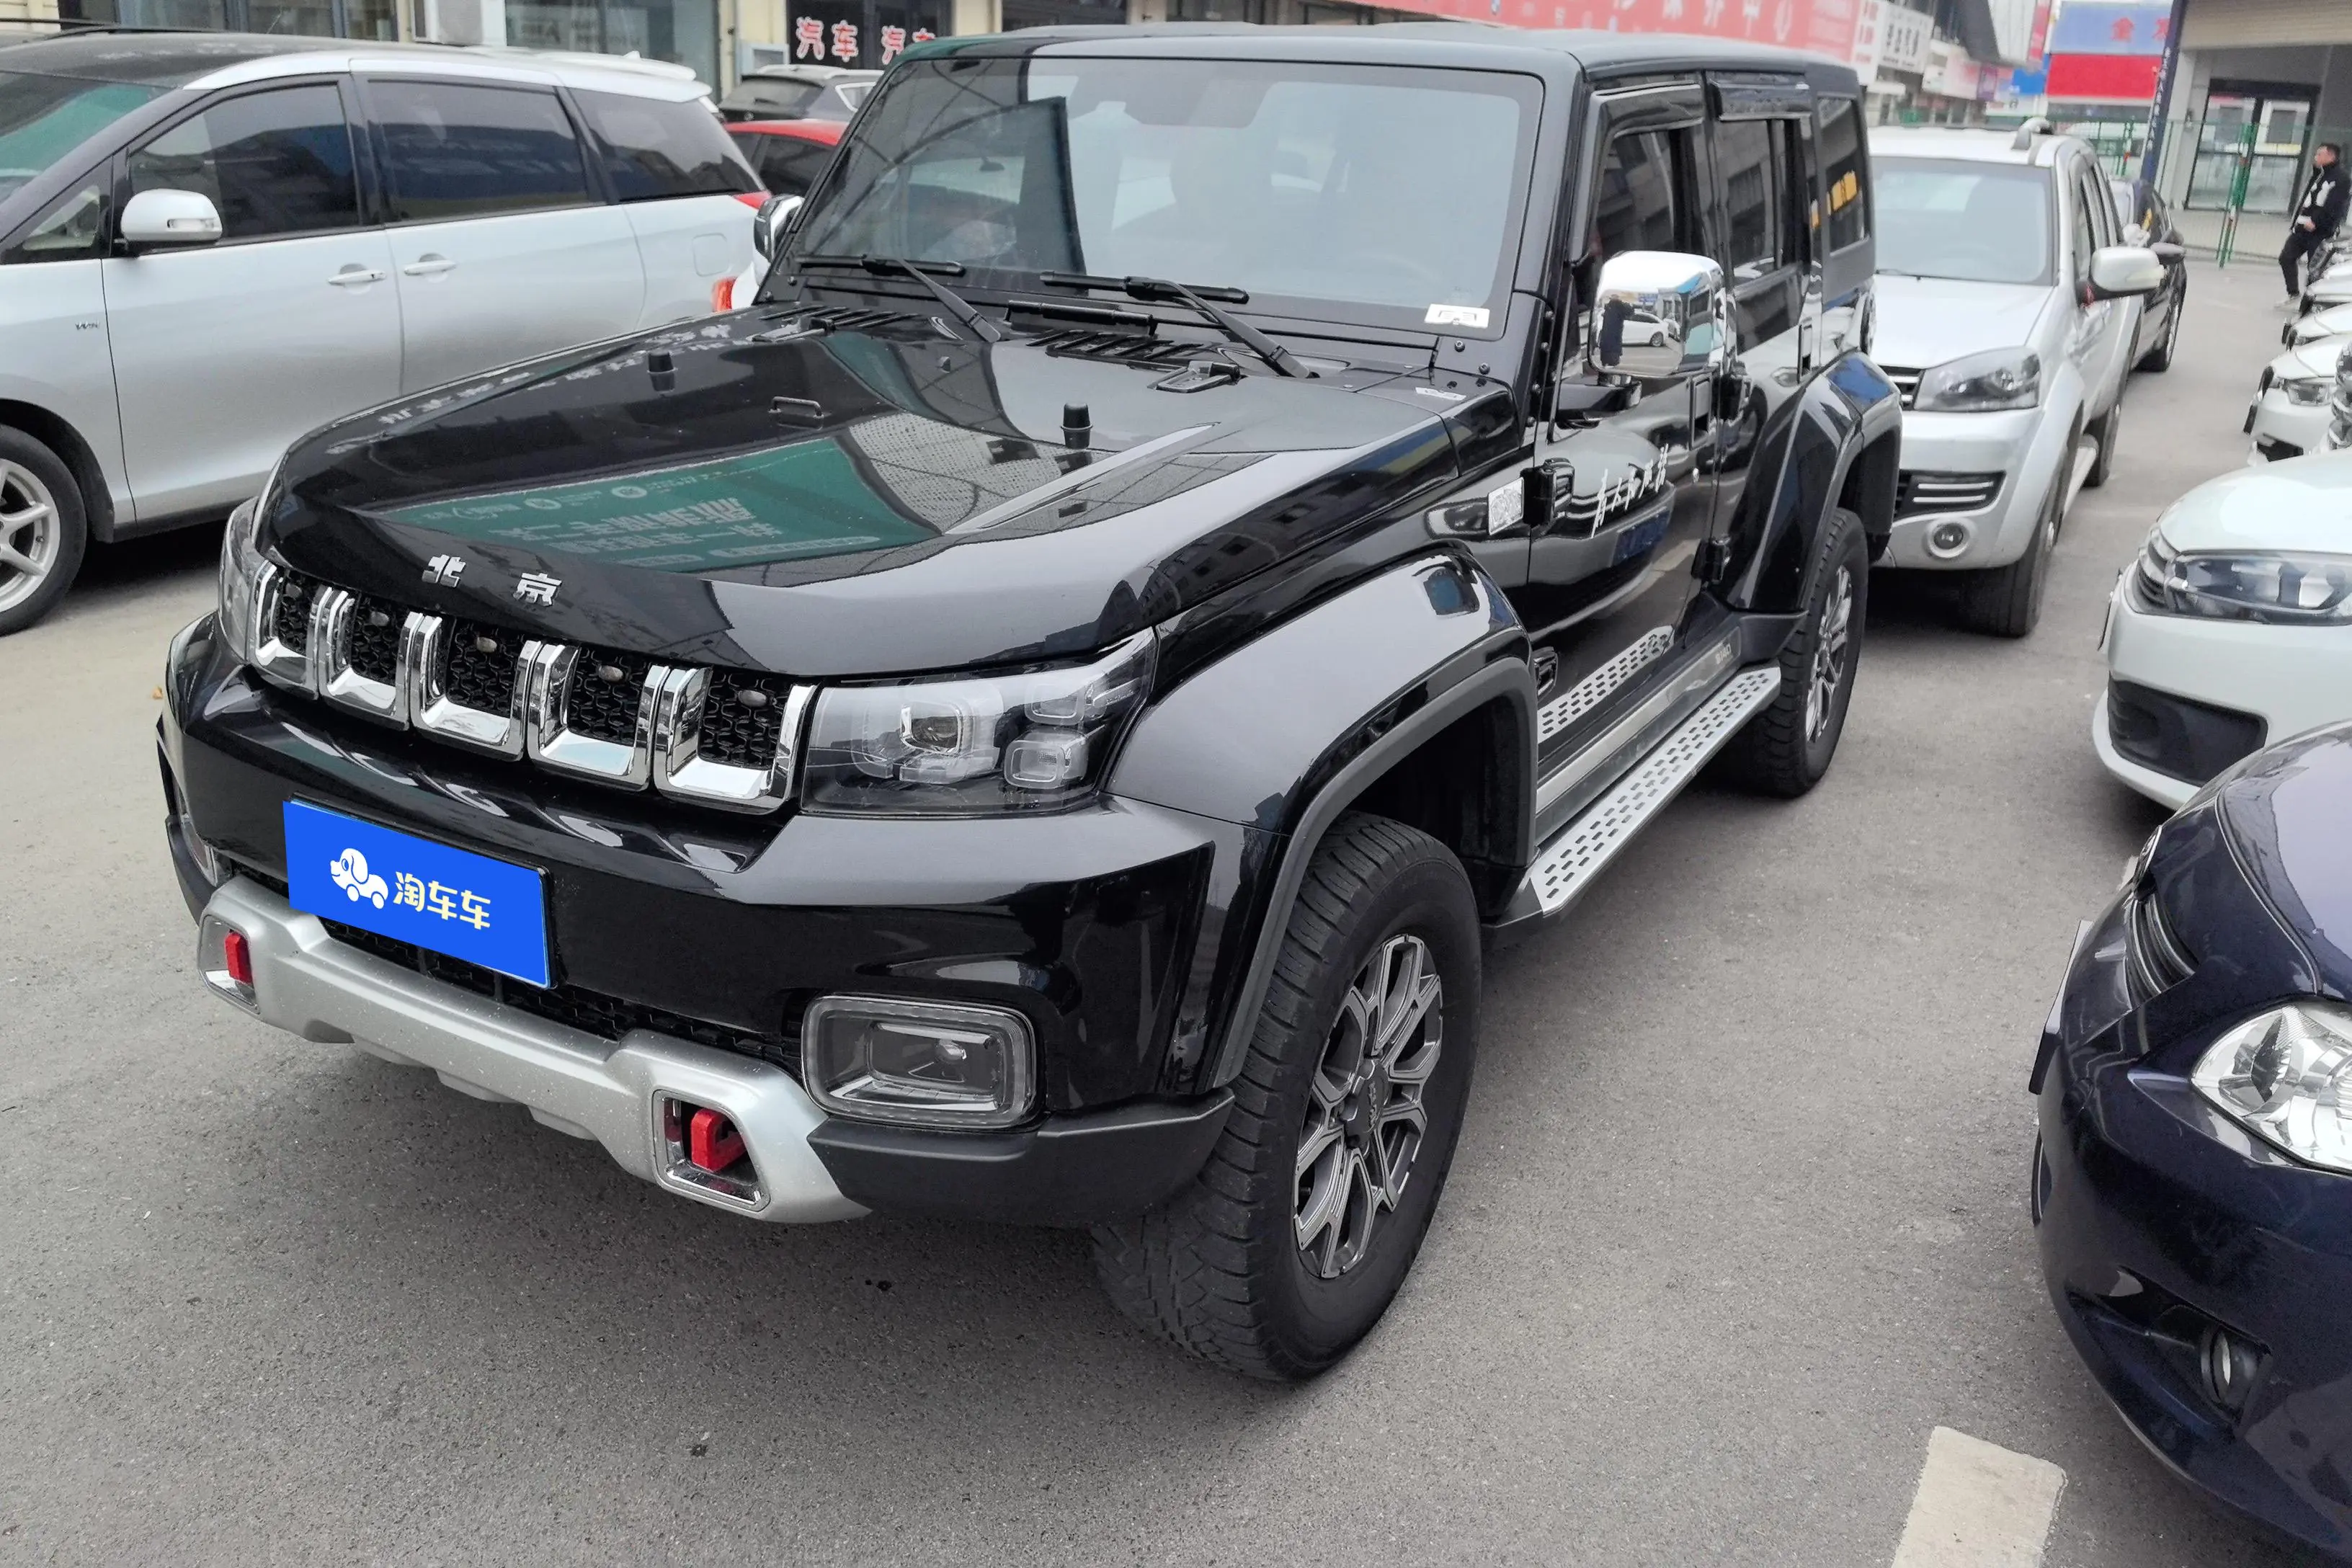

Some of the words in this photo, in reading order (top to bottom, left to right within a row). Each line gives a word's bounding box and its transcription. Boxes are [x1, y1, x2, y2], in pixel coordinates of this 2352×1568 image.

[796, 16, 859, 63] 汽车
[881, 24, 936, 66] 汽
[422, 554, 563, 607] 北京
